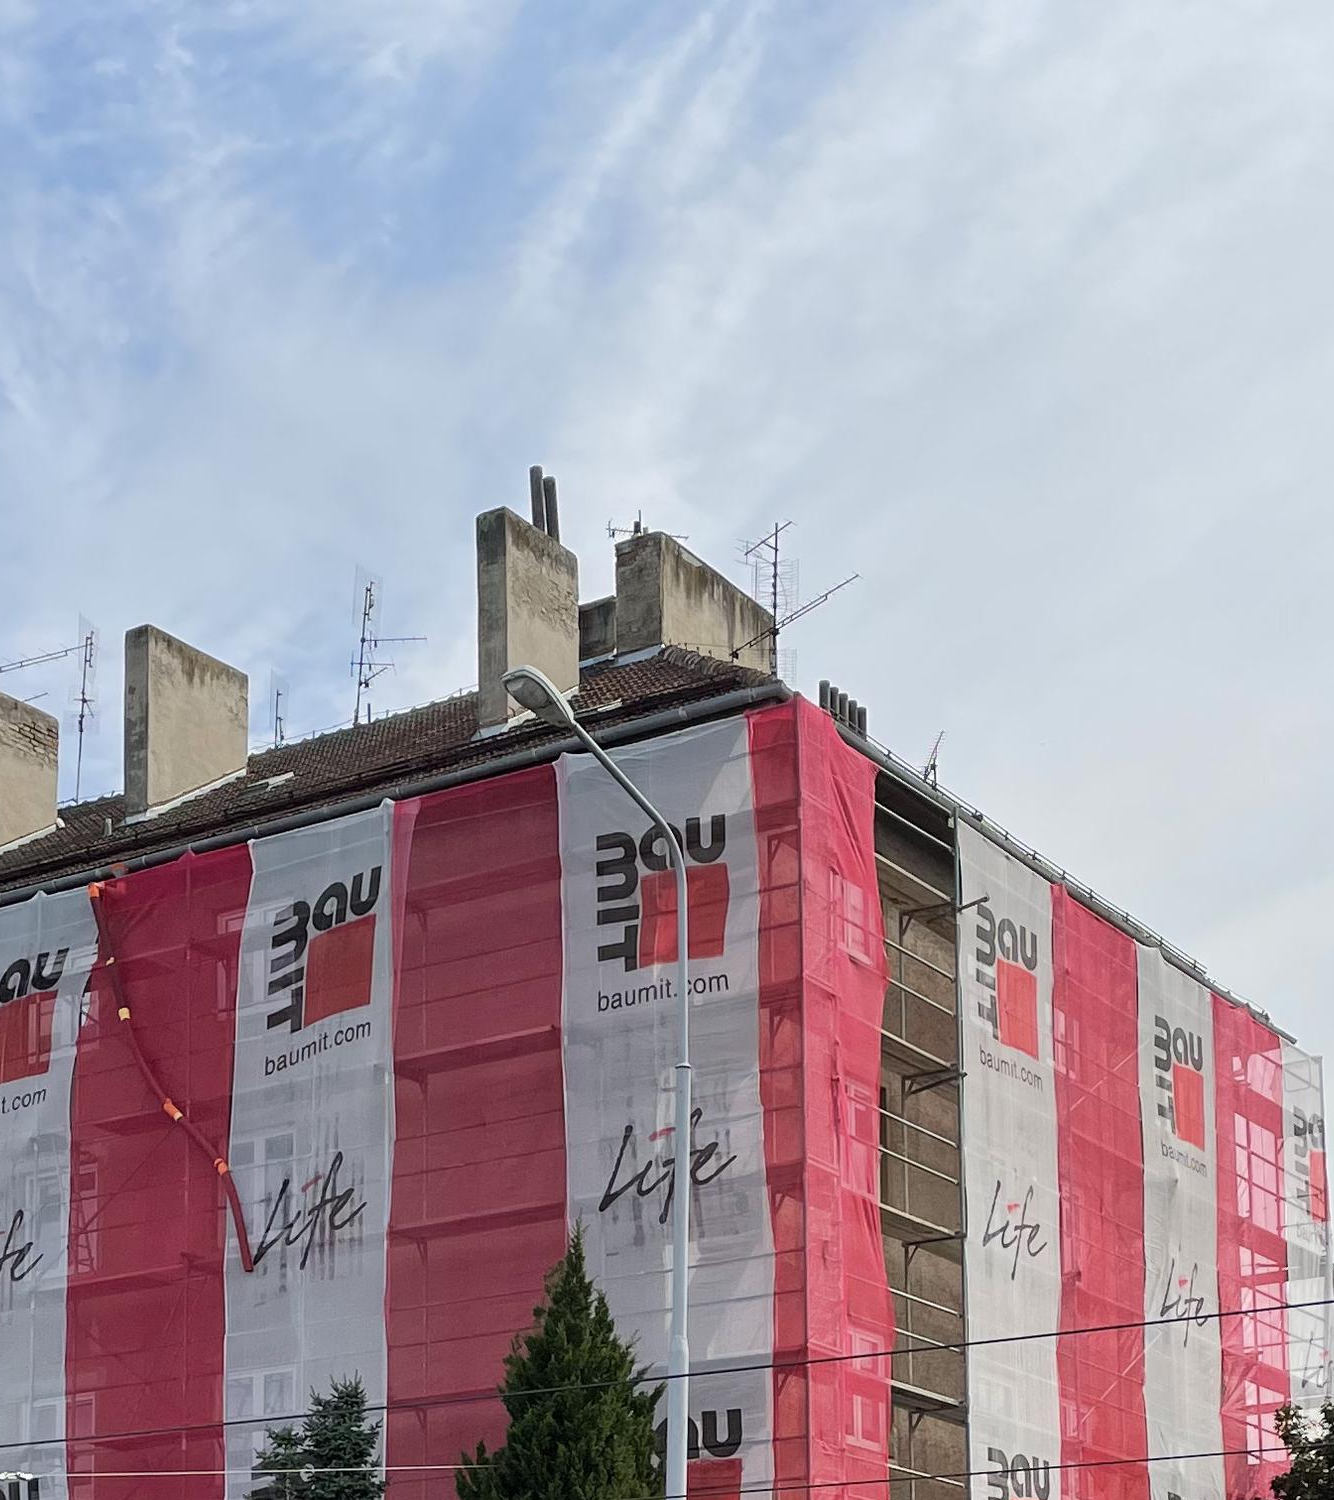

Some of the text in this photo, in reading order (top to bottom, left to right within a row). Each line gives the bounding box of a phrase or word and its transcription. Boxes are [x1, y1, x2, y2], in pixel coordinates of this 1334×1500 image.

[265, 1021, 371, 1076] baumit.com
[980, 1044, 1043, 1091] baumit.com
[253, 1151, 367, 1270] Life
[983, 1180, 1047, 1280] Life
[1160, 1258, 1208, 1348] Life
